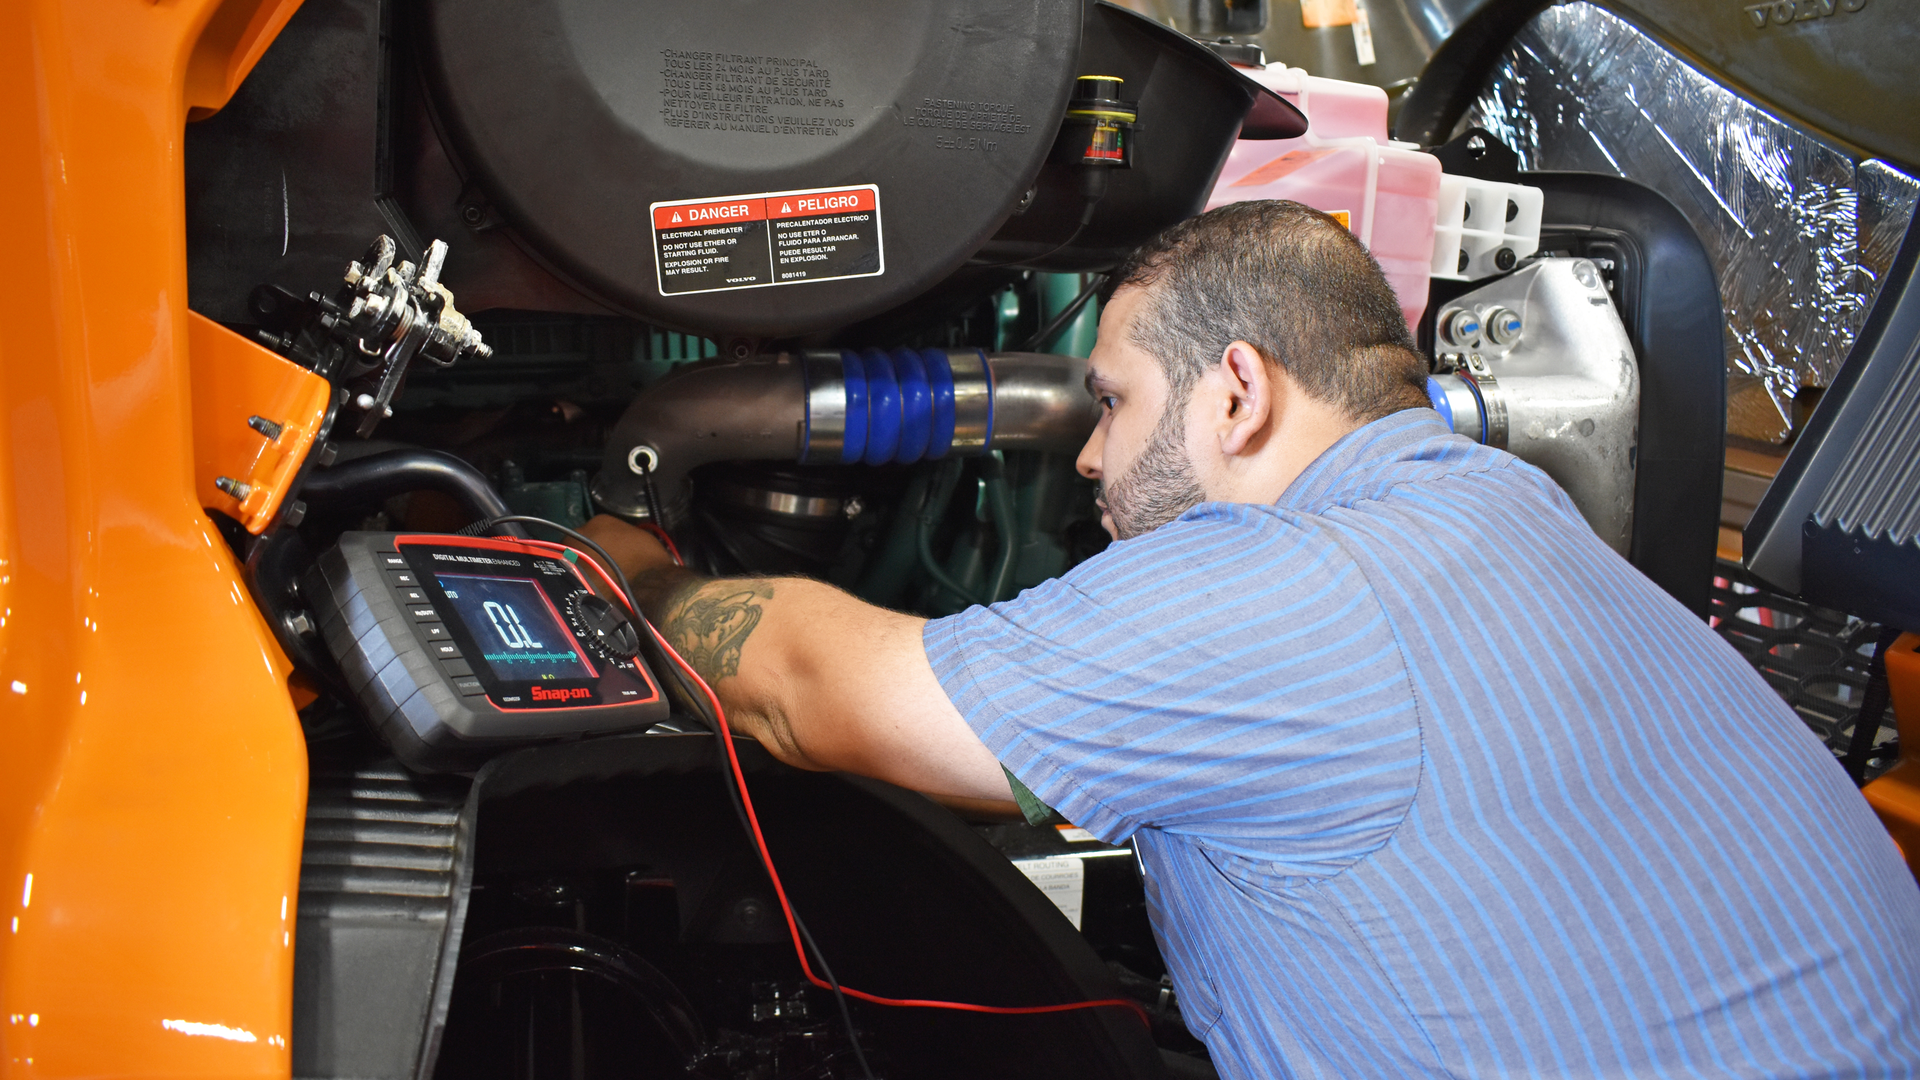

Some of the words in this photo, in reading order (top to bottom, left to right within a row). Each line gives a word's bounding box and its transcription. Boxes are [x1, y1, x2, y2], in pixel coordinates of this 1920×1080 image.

[716, 54, 763, 64] FILTRANT
[766, 57, 818, 68] PRINCIPAL
[664, 59, 690, 69] TOUS
[694, 62, 712, 71] LES
[716, 64, 726, 72] 24
[730, 65, 754, 74] MOIS
[774, 68, 800, 76] PLUS
[803, 69, 829, 78] TARD
[716, 74, 762, 84] FILTRANT
[766, 77, 779, 86] DE
[664, 79, 690, 89] TOUS
[694, 82, 712, 91] LES
[716, 84, 726, 92] 48
[729, 85, 754, 94] MOIS
[774, 87, 798, 96] PLUS
[802, 89, 828, 98] TARD
[664, 99, 716, 110] NETTOYER
[734, 104, 768, 114] FILTRE
[694, 92, 742, 102] MEILLEUR
[808, 99, 821, 107] NE
[824, 99, 844, 108] PAS
[924, 98, 975, 110] FASTENING
[979, 103, 1014, 112] TORQUE
[692, 111, 774, 124] D'INSTRUCTIONS
[778, 116, 824, 126] VEUILLEZ
[828, 119, 854, 127] VOUS
[916, 108, 952, 118] TORQUE
[956, 111, 967, 120] DE
[1010, 114, 1021, 124] DE
[730, 124, 770, 133] MANUEL
[774, 126, 838, 136] D'ENTRETIEN
[904, 117, 914, 126] LE
[918, 118, 952, 128] COUPLE
[956, 120, 967, 129] DE
[970, 121, 1012, 132] SERRAGE
[1014, 124, 1031, 134] EST
[798, 196, 858, 211] PELIGRO
[689, 205, 749, 220] DANGER
[777, 218, 832, 228] PRECALENTADOR
[834, 215, 869, 223] ELECTRICO
[662, 231, 702, 240] ELECTRICAL
[704, 227, 743, 236] PREHEATER
[822, 234, 859, 242] ARRANCAR.
[664, 250, 696, 258] STARTING
[802, 246, 836, 254] RESULTAR
[665, 260, 702, 268] EXPLOSION
[790, 254, 828, 262] EXPLOSION.
[682, 266, 708, 274] RESULT.
[531, 686, 592, 702] Snap-on
[1034, 861, 1070, 870] ROUTING
